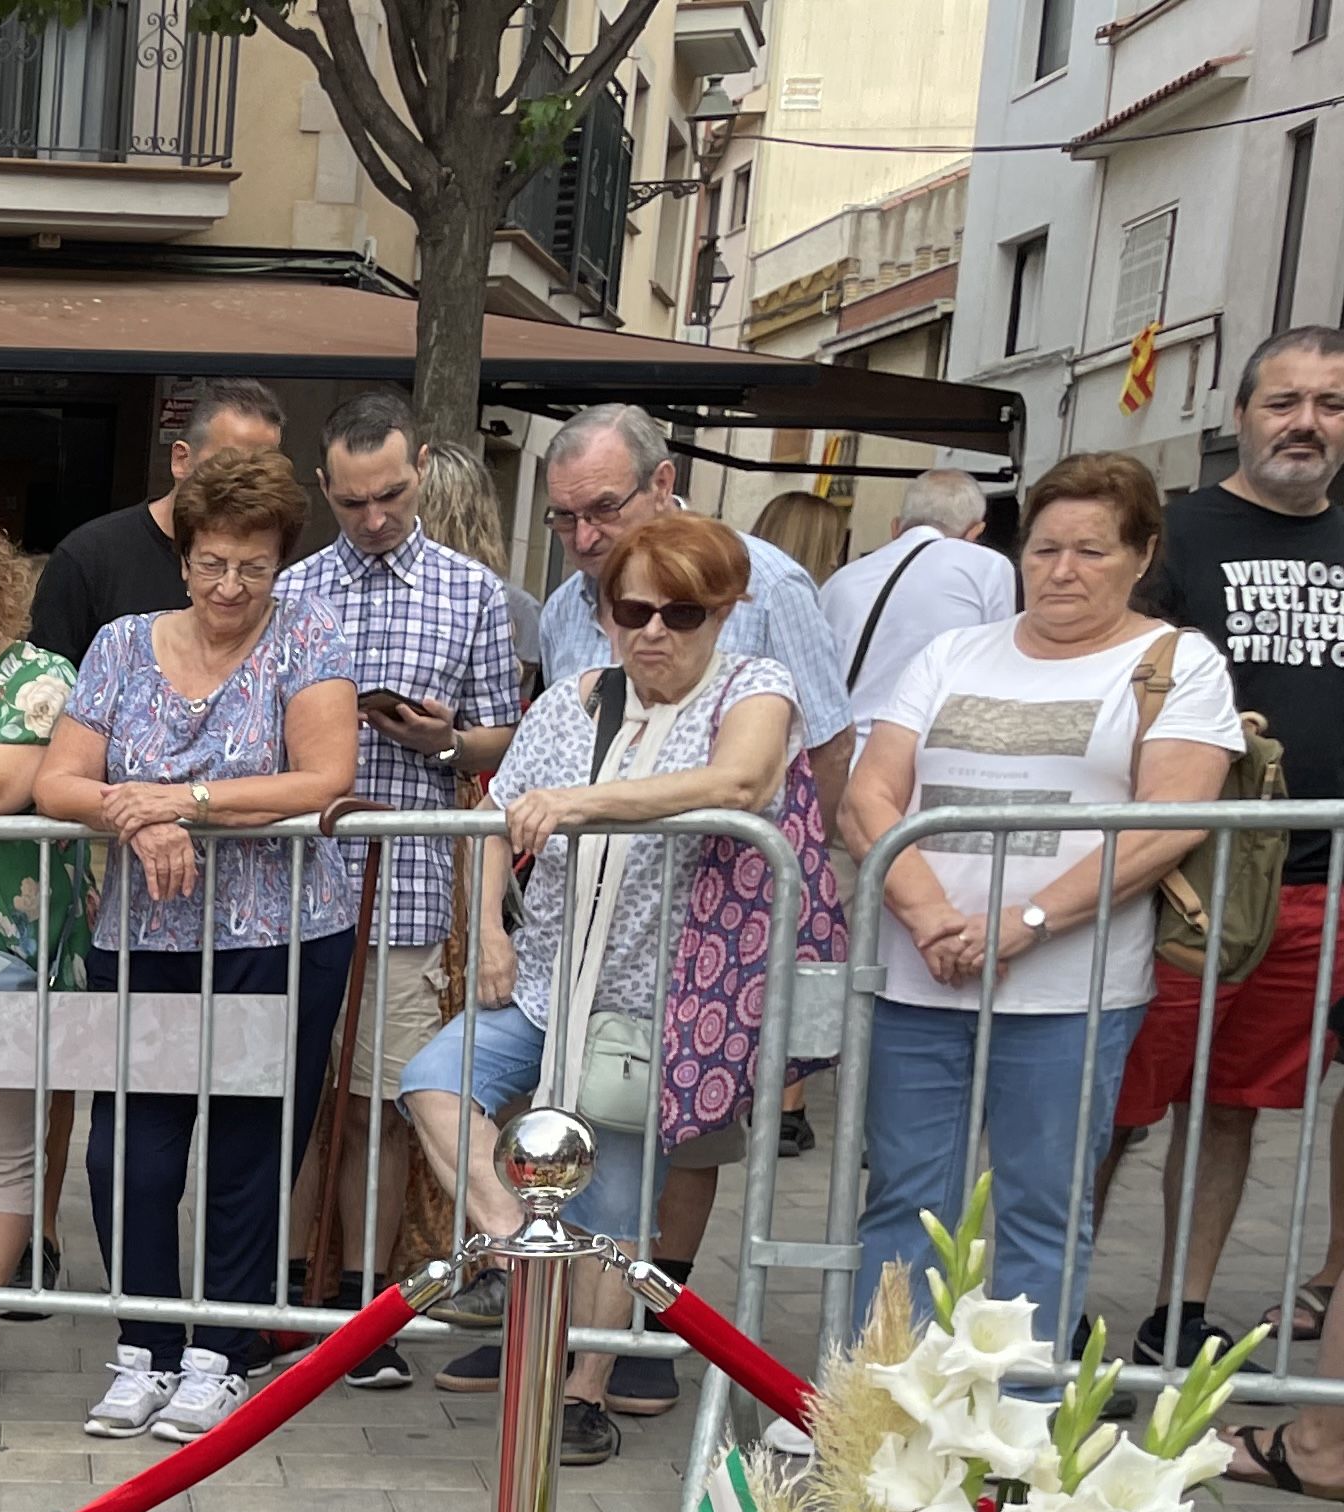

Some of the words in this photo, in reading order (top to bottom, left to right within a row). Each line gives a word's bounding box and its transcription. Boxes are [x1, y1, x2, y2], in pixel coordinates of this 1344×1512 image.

[1220, 559, 1308, 587] WHEN
[1240, 585, 1305, 612] FEEL
[1307, 586, 1344, 615] FE
[1227, 634, 1327, 667] TRUST
